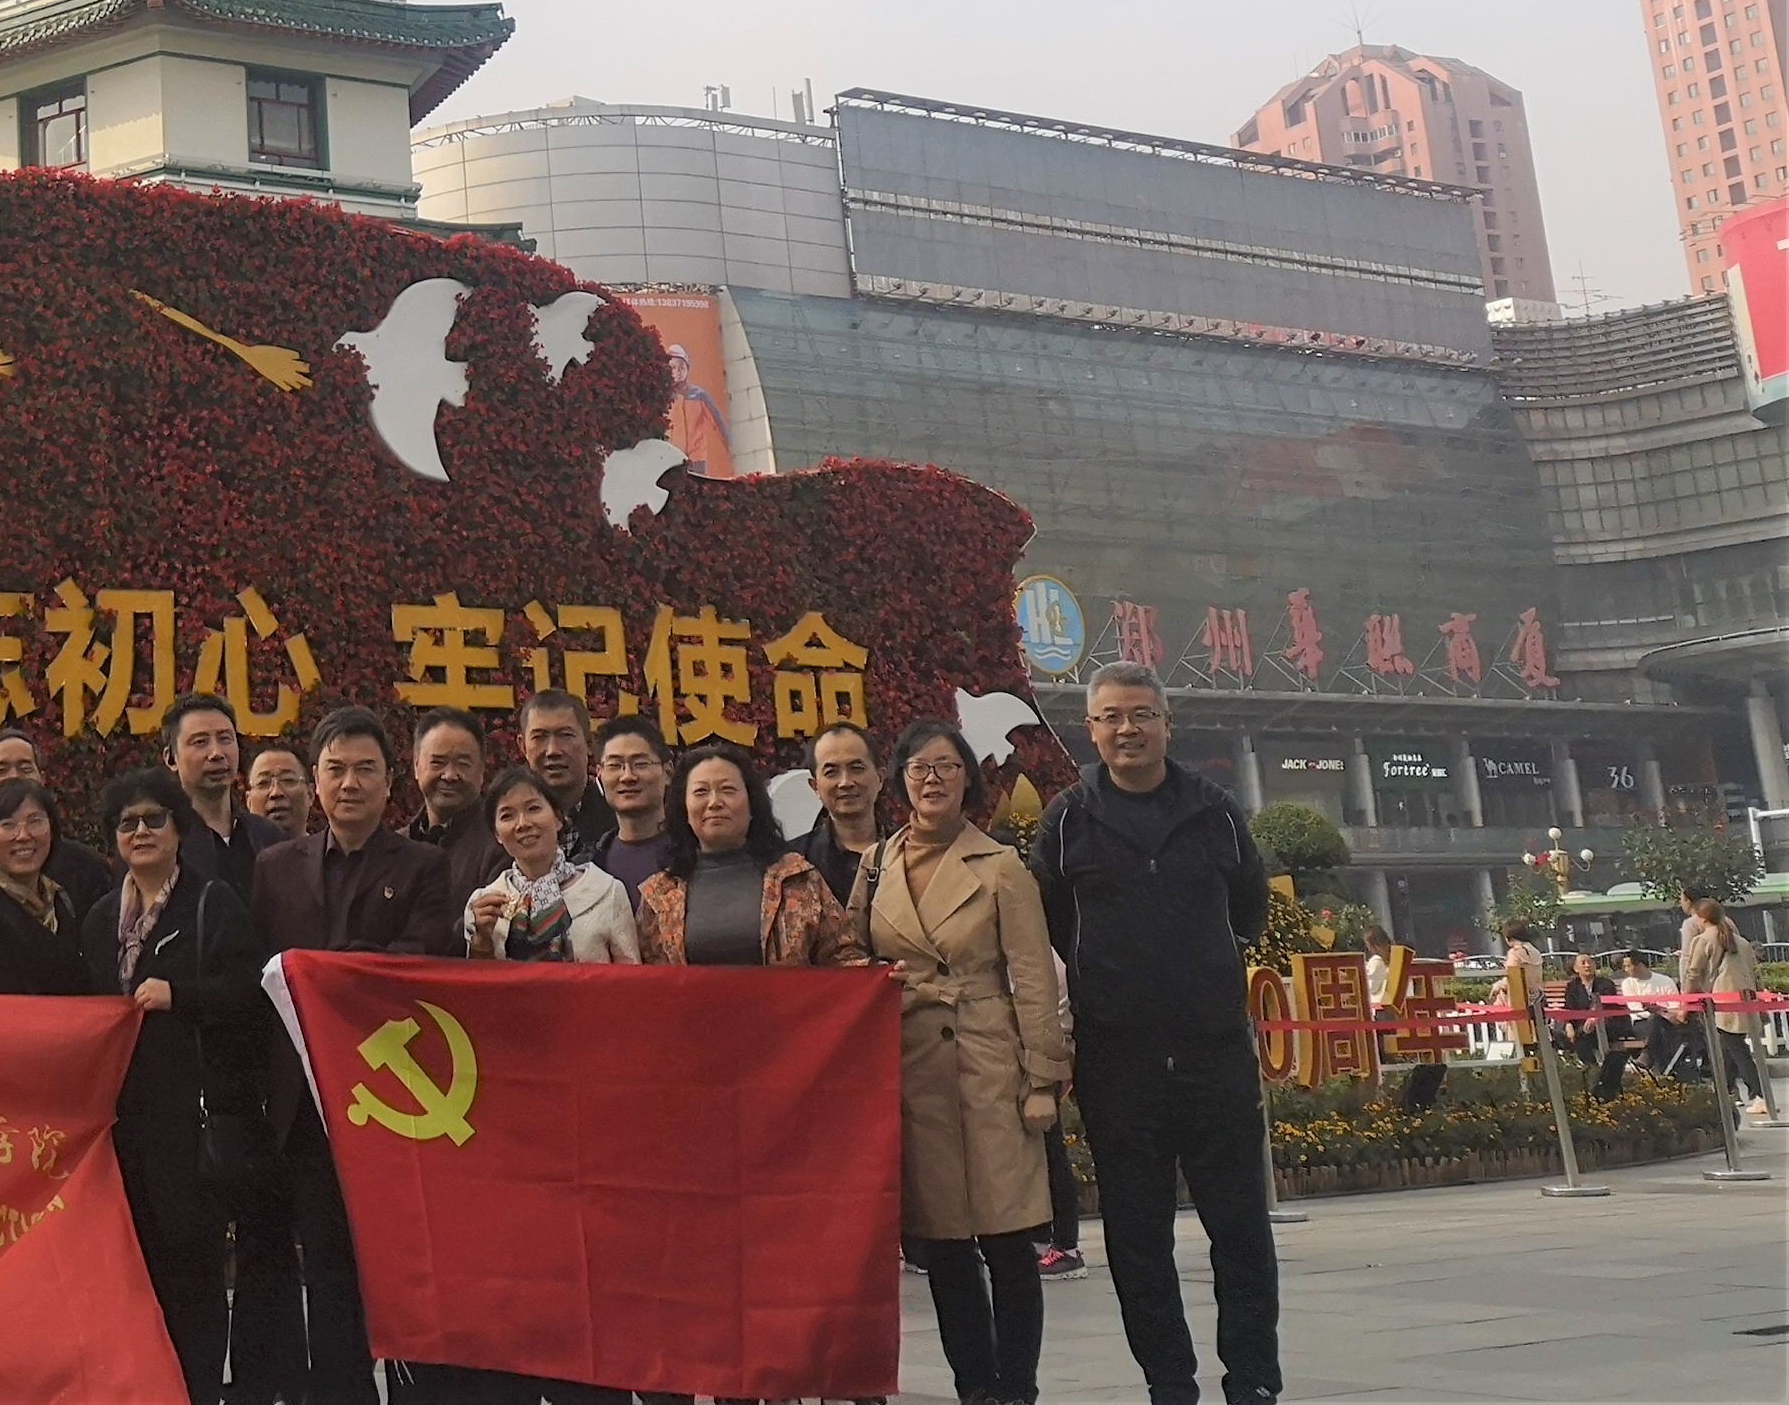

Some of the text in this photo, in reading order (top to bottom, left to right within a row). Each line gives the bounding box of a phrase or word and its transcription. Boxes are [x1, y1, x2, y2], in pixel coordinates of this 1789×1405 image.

[391, 590, 871, 747] 牢记使命
[1281, 758, 1308, 770] JACK
[1498, 762, 1540, 775] CAMEL
